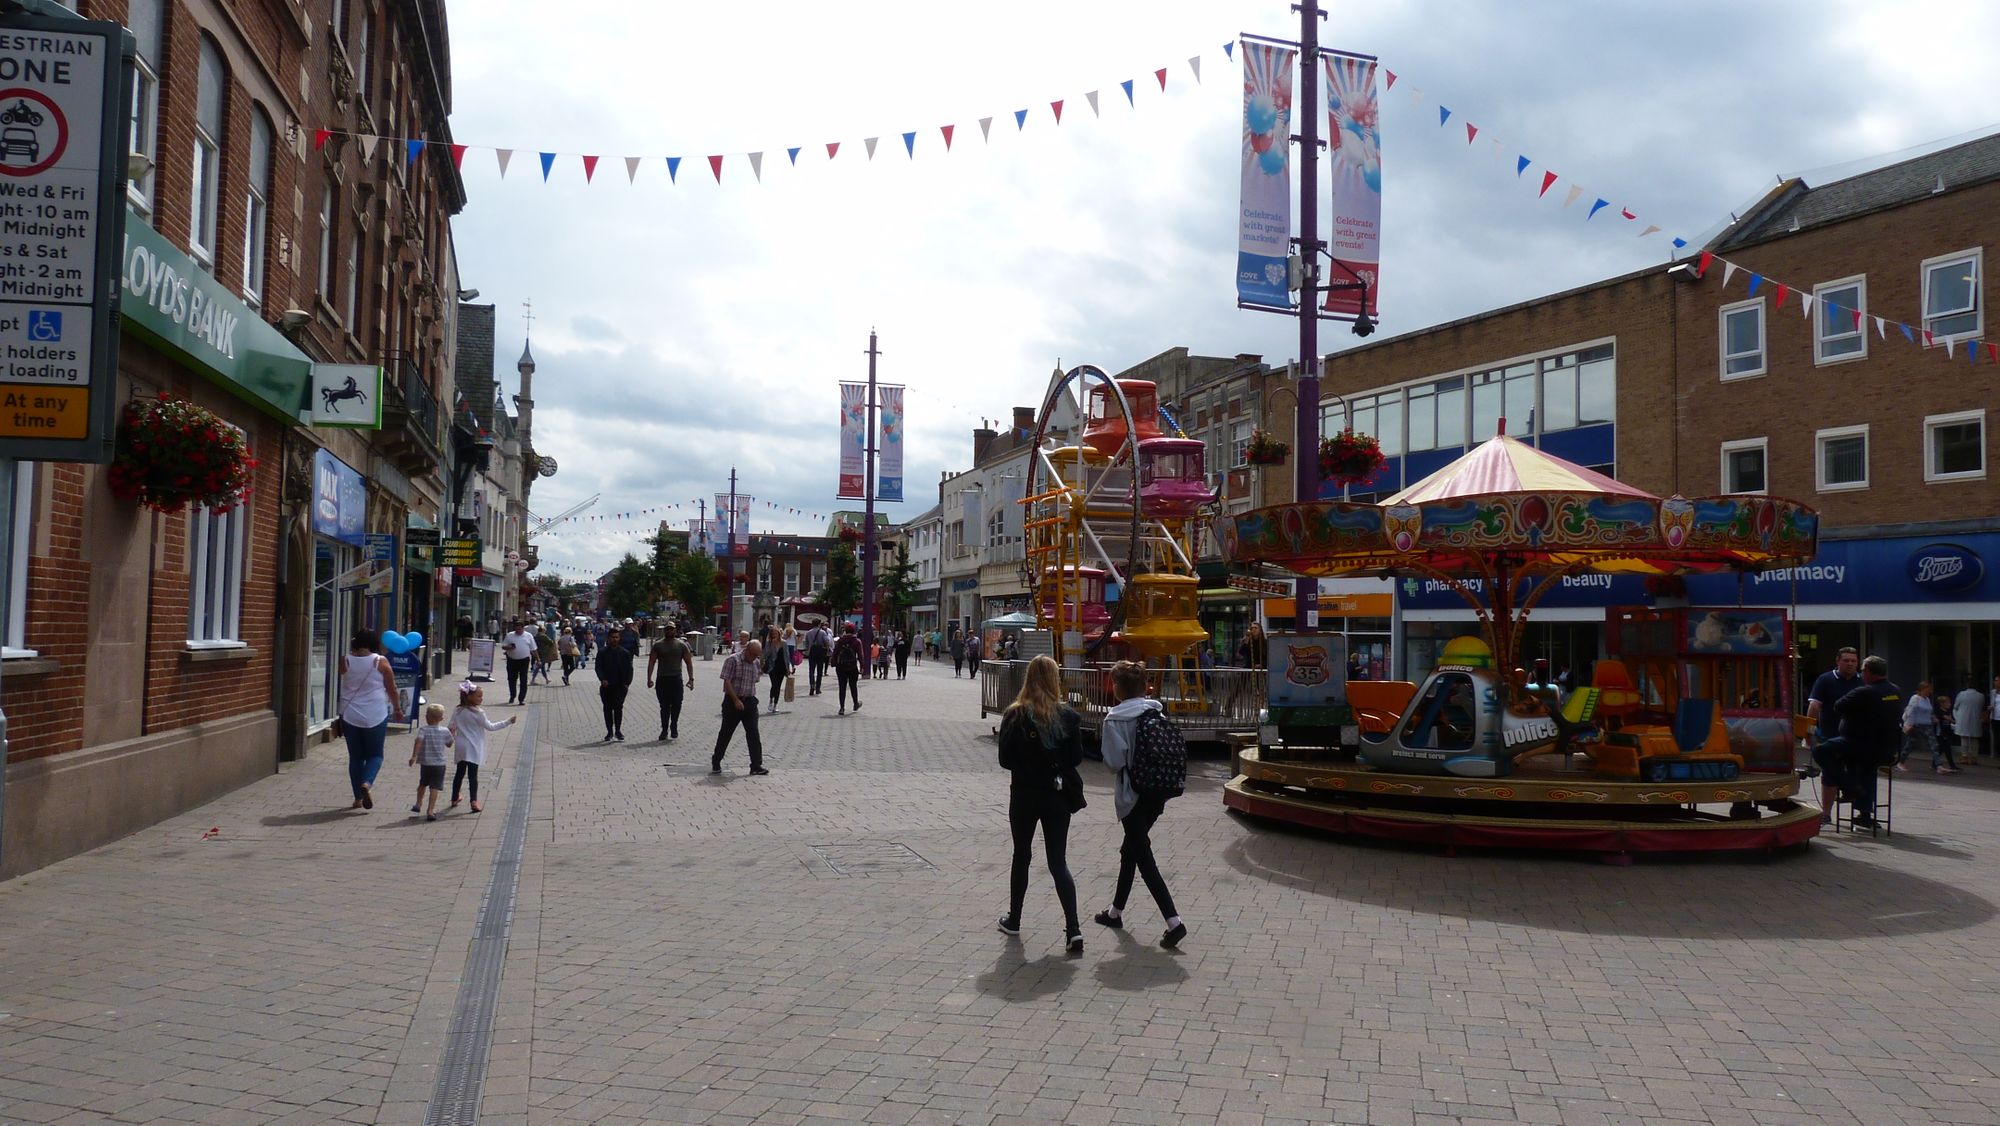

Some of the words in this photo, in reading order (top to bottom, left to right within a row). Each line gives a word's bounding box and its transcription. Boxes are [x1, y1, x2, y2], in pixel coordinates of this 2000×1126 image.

[0, 57, 71, 84] ONE
[0, 183, 38, 198] Wed
[44, 185, 55, 199] &
[61, 186, 85, 200] Fri
[36, 204, 57, 219] 10
[63, 207, 89, 221] am
[1243, 209, 1282, 222] Celebrate
[4, 220, 86, 240] Midnight
[1243, 221, 1263, 231] with
[1265, 223, 1286, 234] great
[1336, 215, 1374, 229] Celebrate
[1336, 228, 1354, 237] with
[1356, 230, 1377, 241] great
[18, 243, 30, 257] &
[36, 244, 68, 259] Sat
[1336, 240, 1365, 250] events!
[38, 264, 50, 278] 2
[55, 267, 82, 280] am
[1240, 271, 1259, 280] LOVE
[2, 280, 83, 299] Midnight
[188, 286, 238, 360] BANK
[8, 344, 76, 361] holders
[10, 363, 78, 381] loading
[4, 392, 26, 408] At
[34, 395, 68, 412] any
[13, 411, 57, 428] time
[320, 466, 338, 501] MAX
[443, 540, 477, 548] SUBWAY
[442, 549, 477, 557] SUBWAY
[442, 558, 477, 566] SUBWAY
[1915, 556, 1963, 582] Boots
[1562, 574, 1612, 589] beauty
[1297, 667, 1319, 680] 35
[1503, 720, 1558, 748] police
